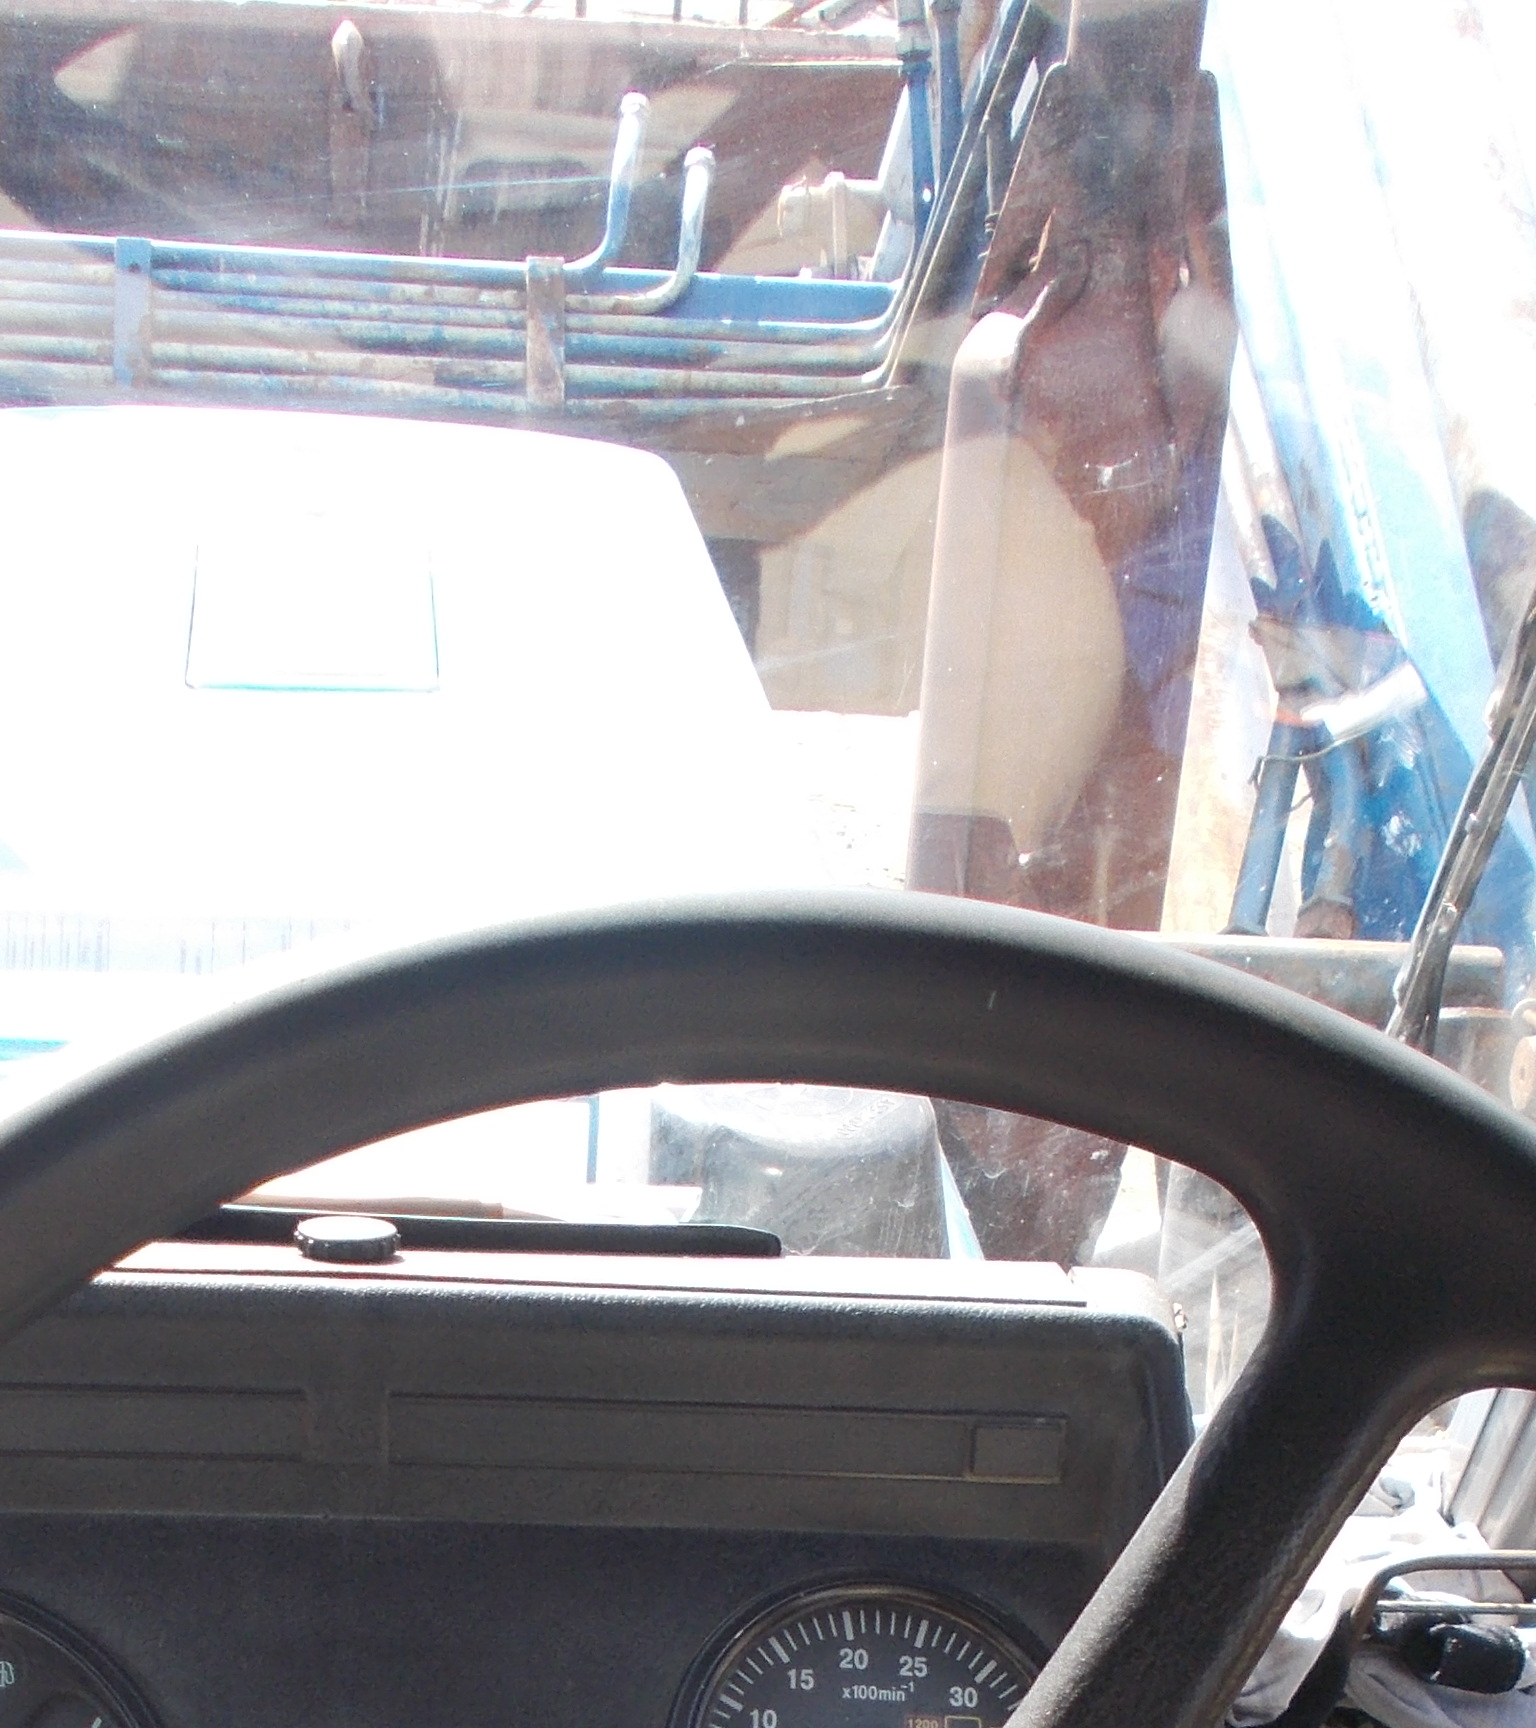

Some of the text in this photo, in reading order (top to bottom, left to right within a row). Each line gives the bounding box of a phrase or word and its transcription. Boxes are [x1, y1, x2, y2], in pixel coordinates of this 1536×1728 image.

[838, 1648, 869, 1670] 20
[898, 1655, 929, 1678] 25
[786, 1668, 815, 1690] 15
[948, 1686, 978, 1708] 30
